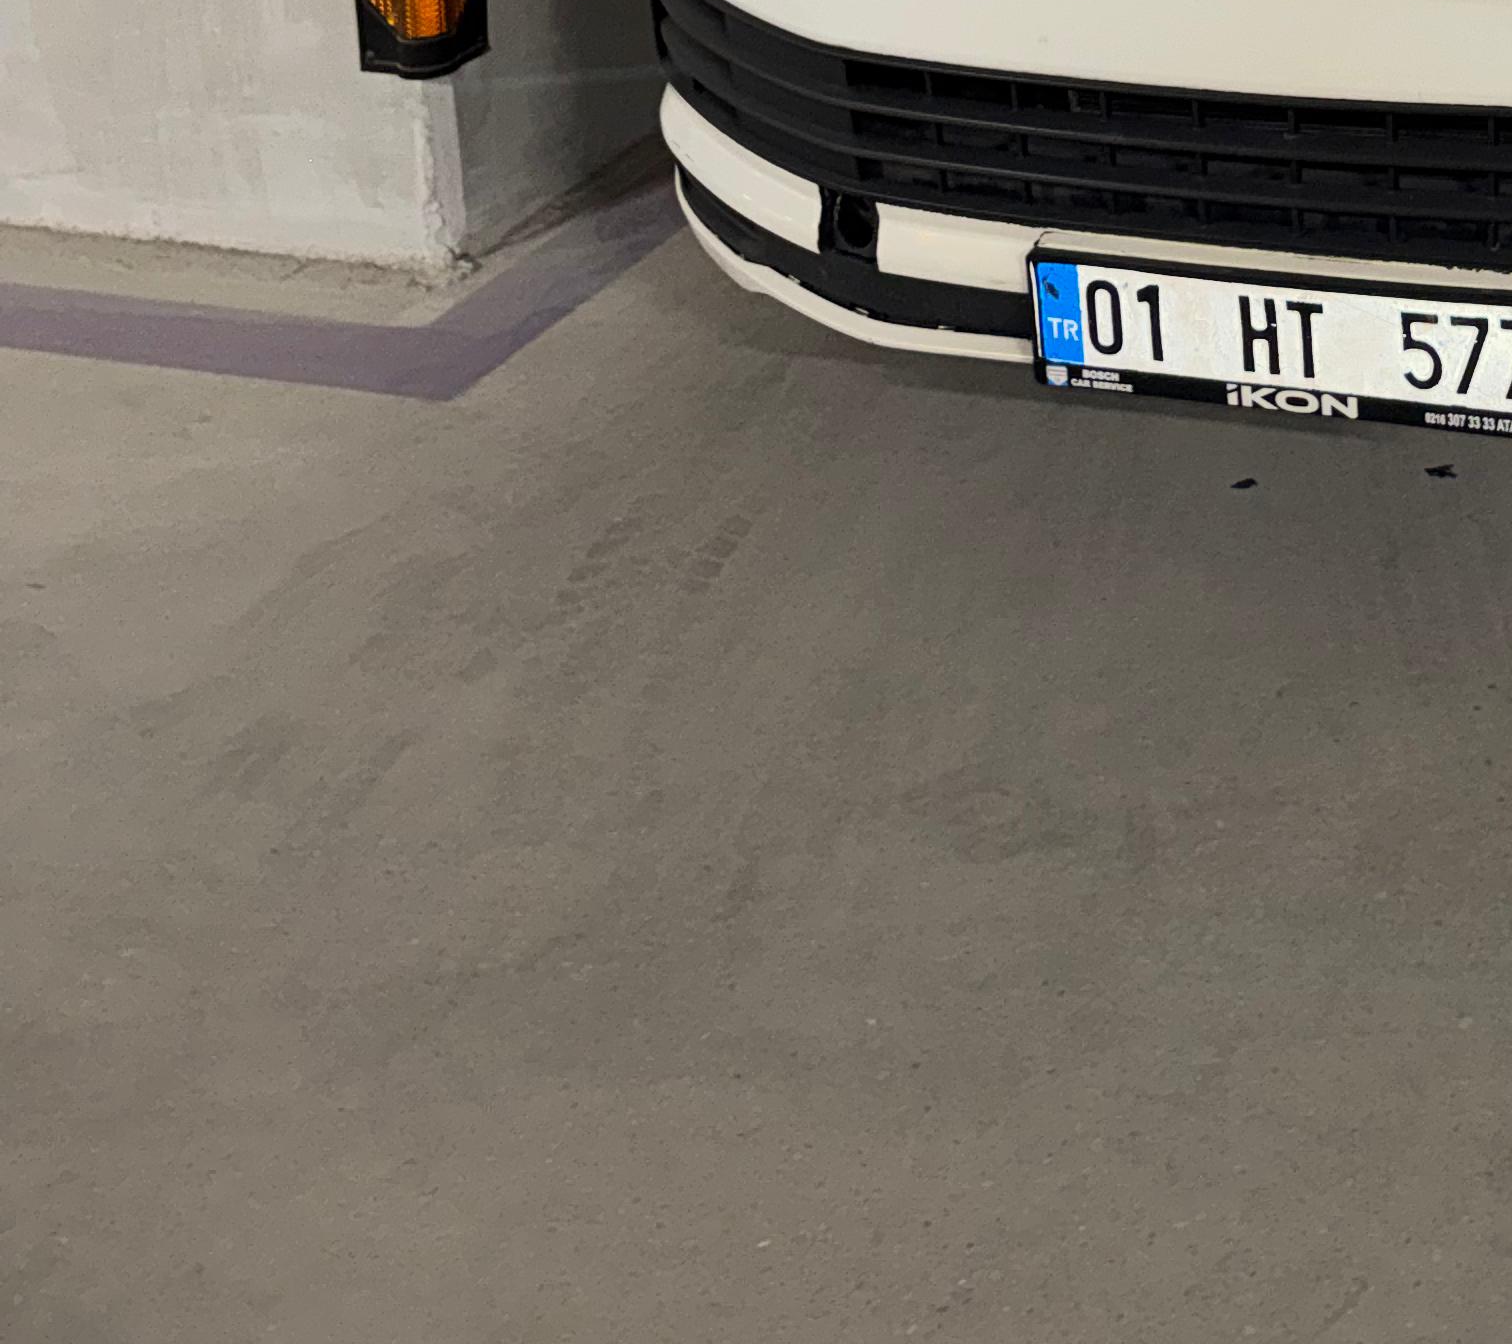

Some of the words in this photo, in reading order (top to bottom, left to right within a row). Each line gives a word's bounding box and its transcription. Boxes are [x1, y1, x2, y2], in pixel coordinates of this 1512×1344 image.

[1046, 315, 1080, 342] TR
[1086, 280, 1165, 362] 01
[1237, 294, 1324, 379] HT
[1081, 368, 1121, 382] BOSCH
[1070, 378, 1093, 389] CAR
[1093, 381, 1134, 393] SERVICE
[1447, 413, 1466, 428] 307
[1467, 415, 1481, 430] 33
[1482, 417, 1496, 431] 33
